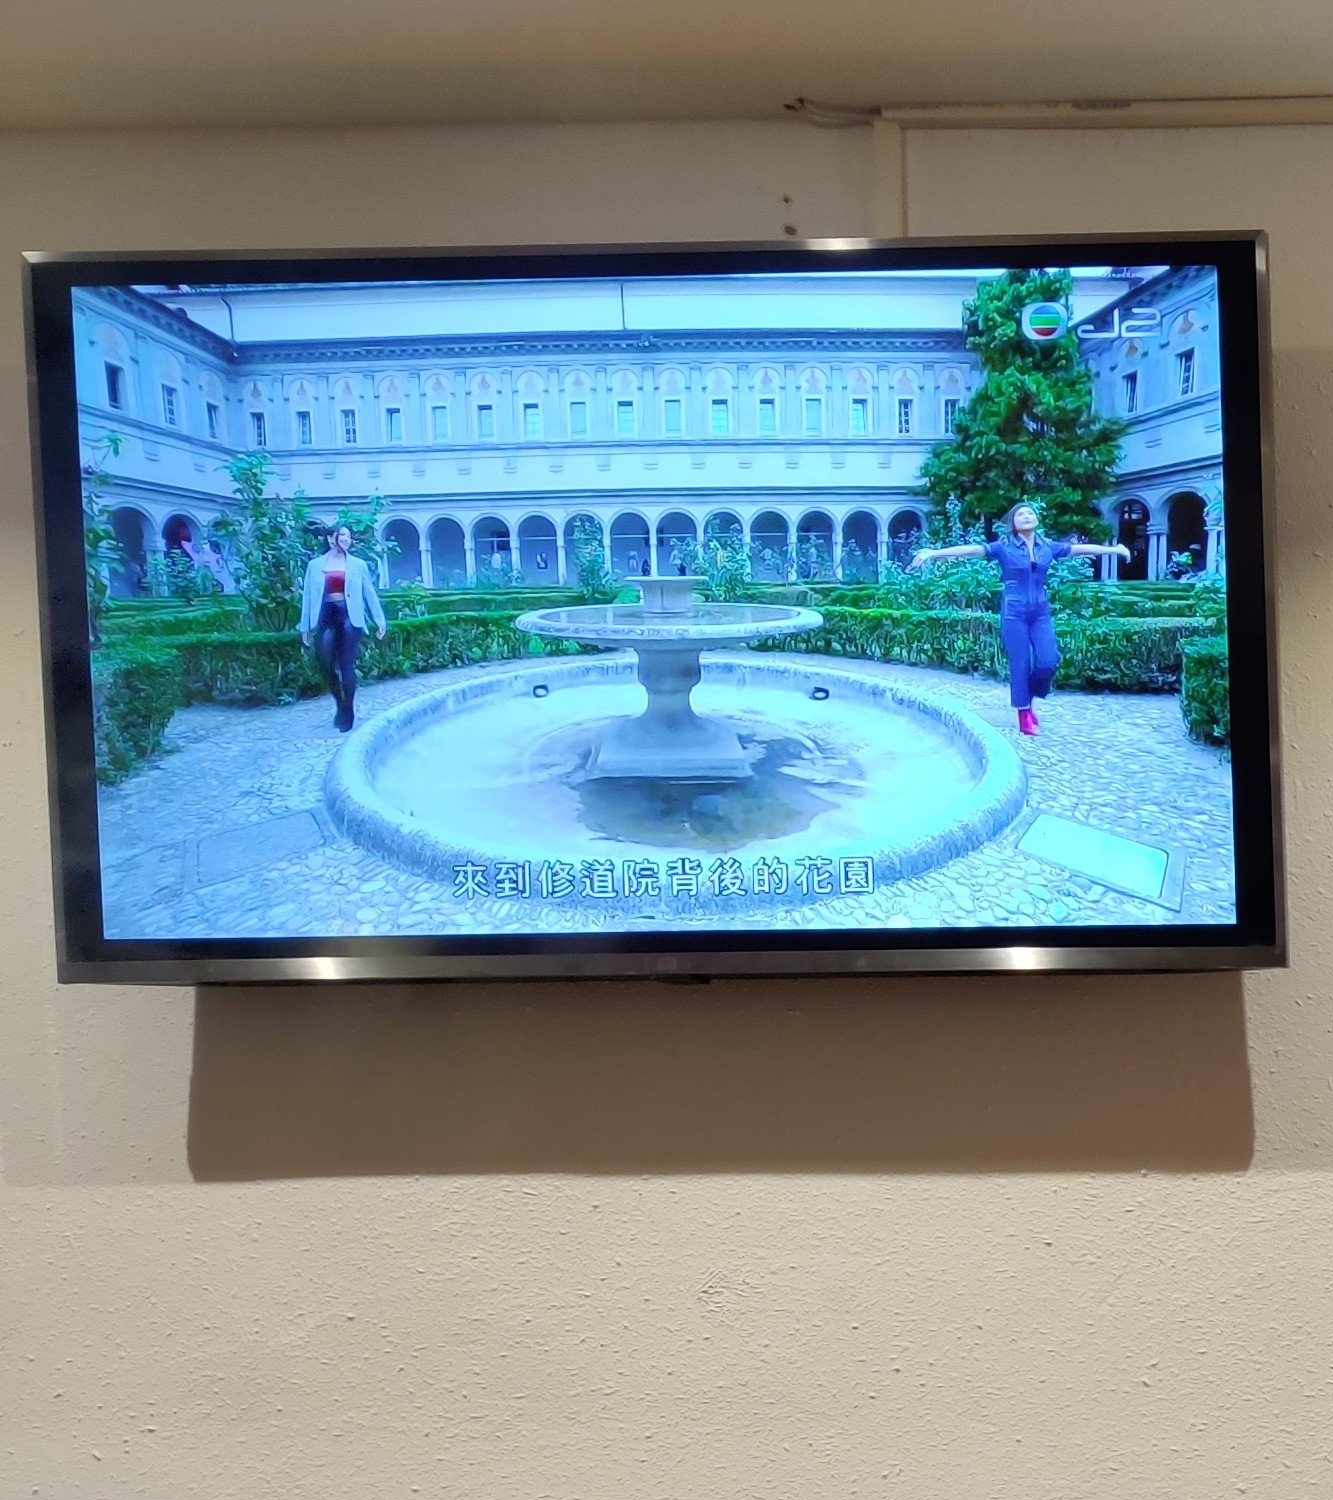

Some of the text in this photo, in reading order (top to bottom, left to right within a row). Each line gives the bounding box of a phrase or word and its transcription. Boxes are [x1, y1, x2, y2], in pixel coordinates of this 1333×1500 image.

[1077, 307, 1161, 339] J2
[453, 856, 876, 900] 來到修道院背後的花園
